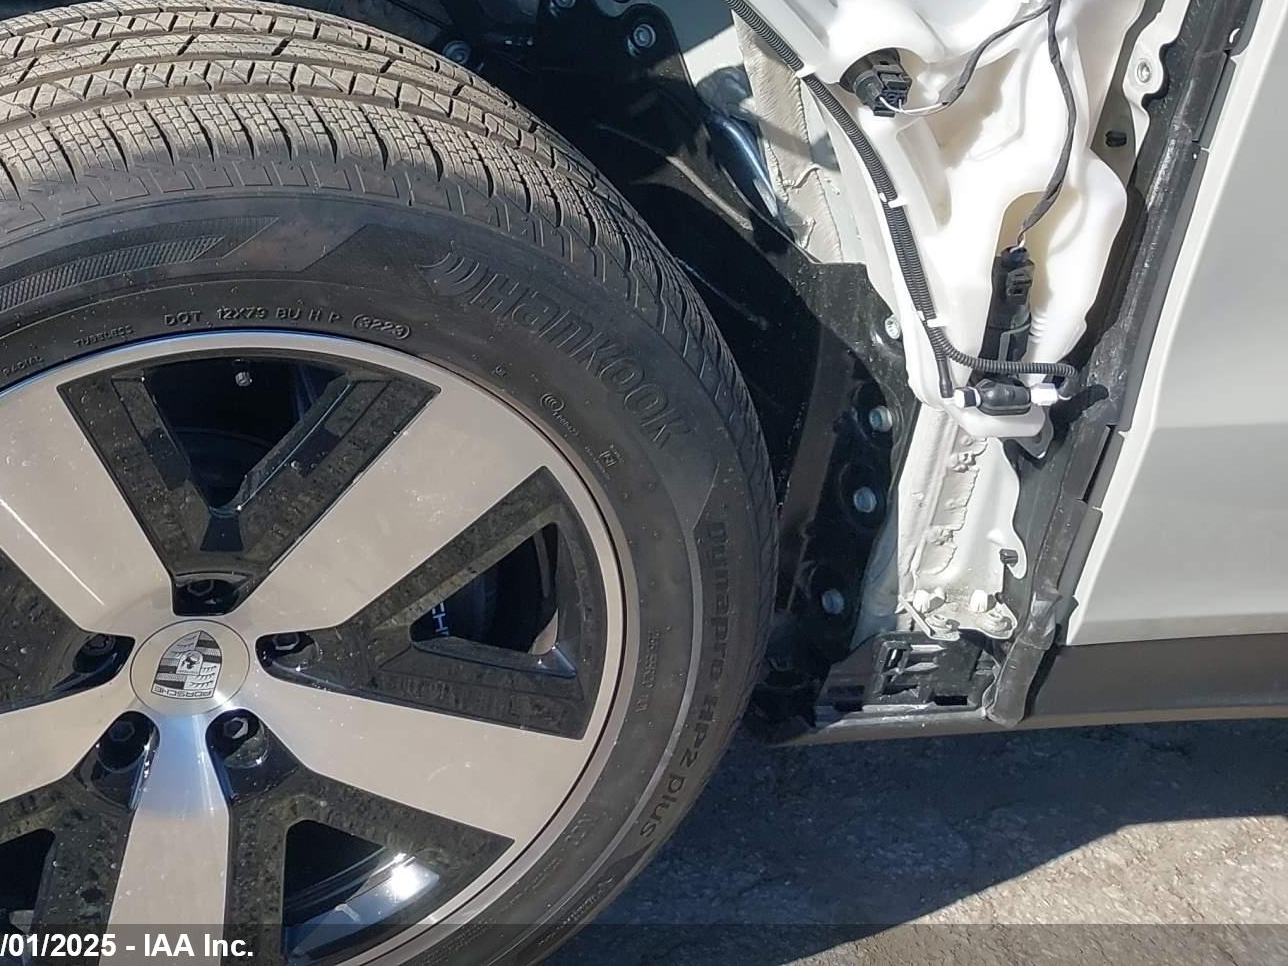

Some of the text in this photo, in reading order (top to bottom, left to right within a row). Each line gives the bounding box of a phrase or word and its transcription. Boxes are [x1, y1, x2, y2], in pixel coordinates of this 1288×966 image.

[164, 309, 202, 326] DOT
[153, 685, 212, 698] PORSCHE
[639, 772, 686, 838] plus
